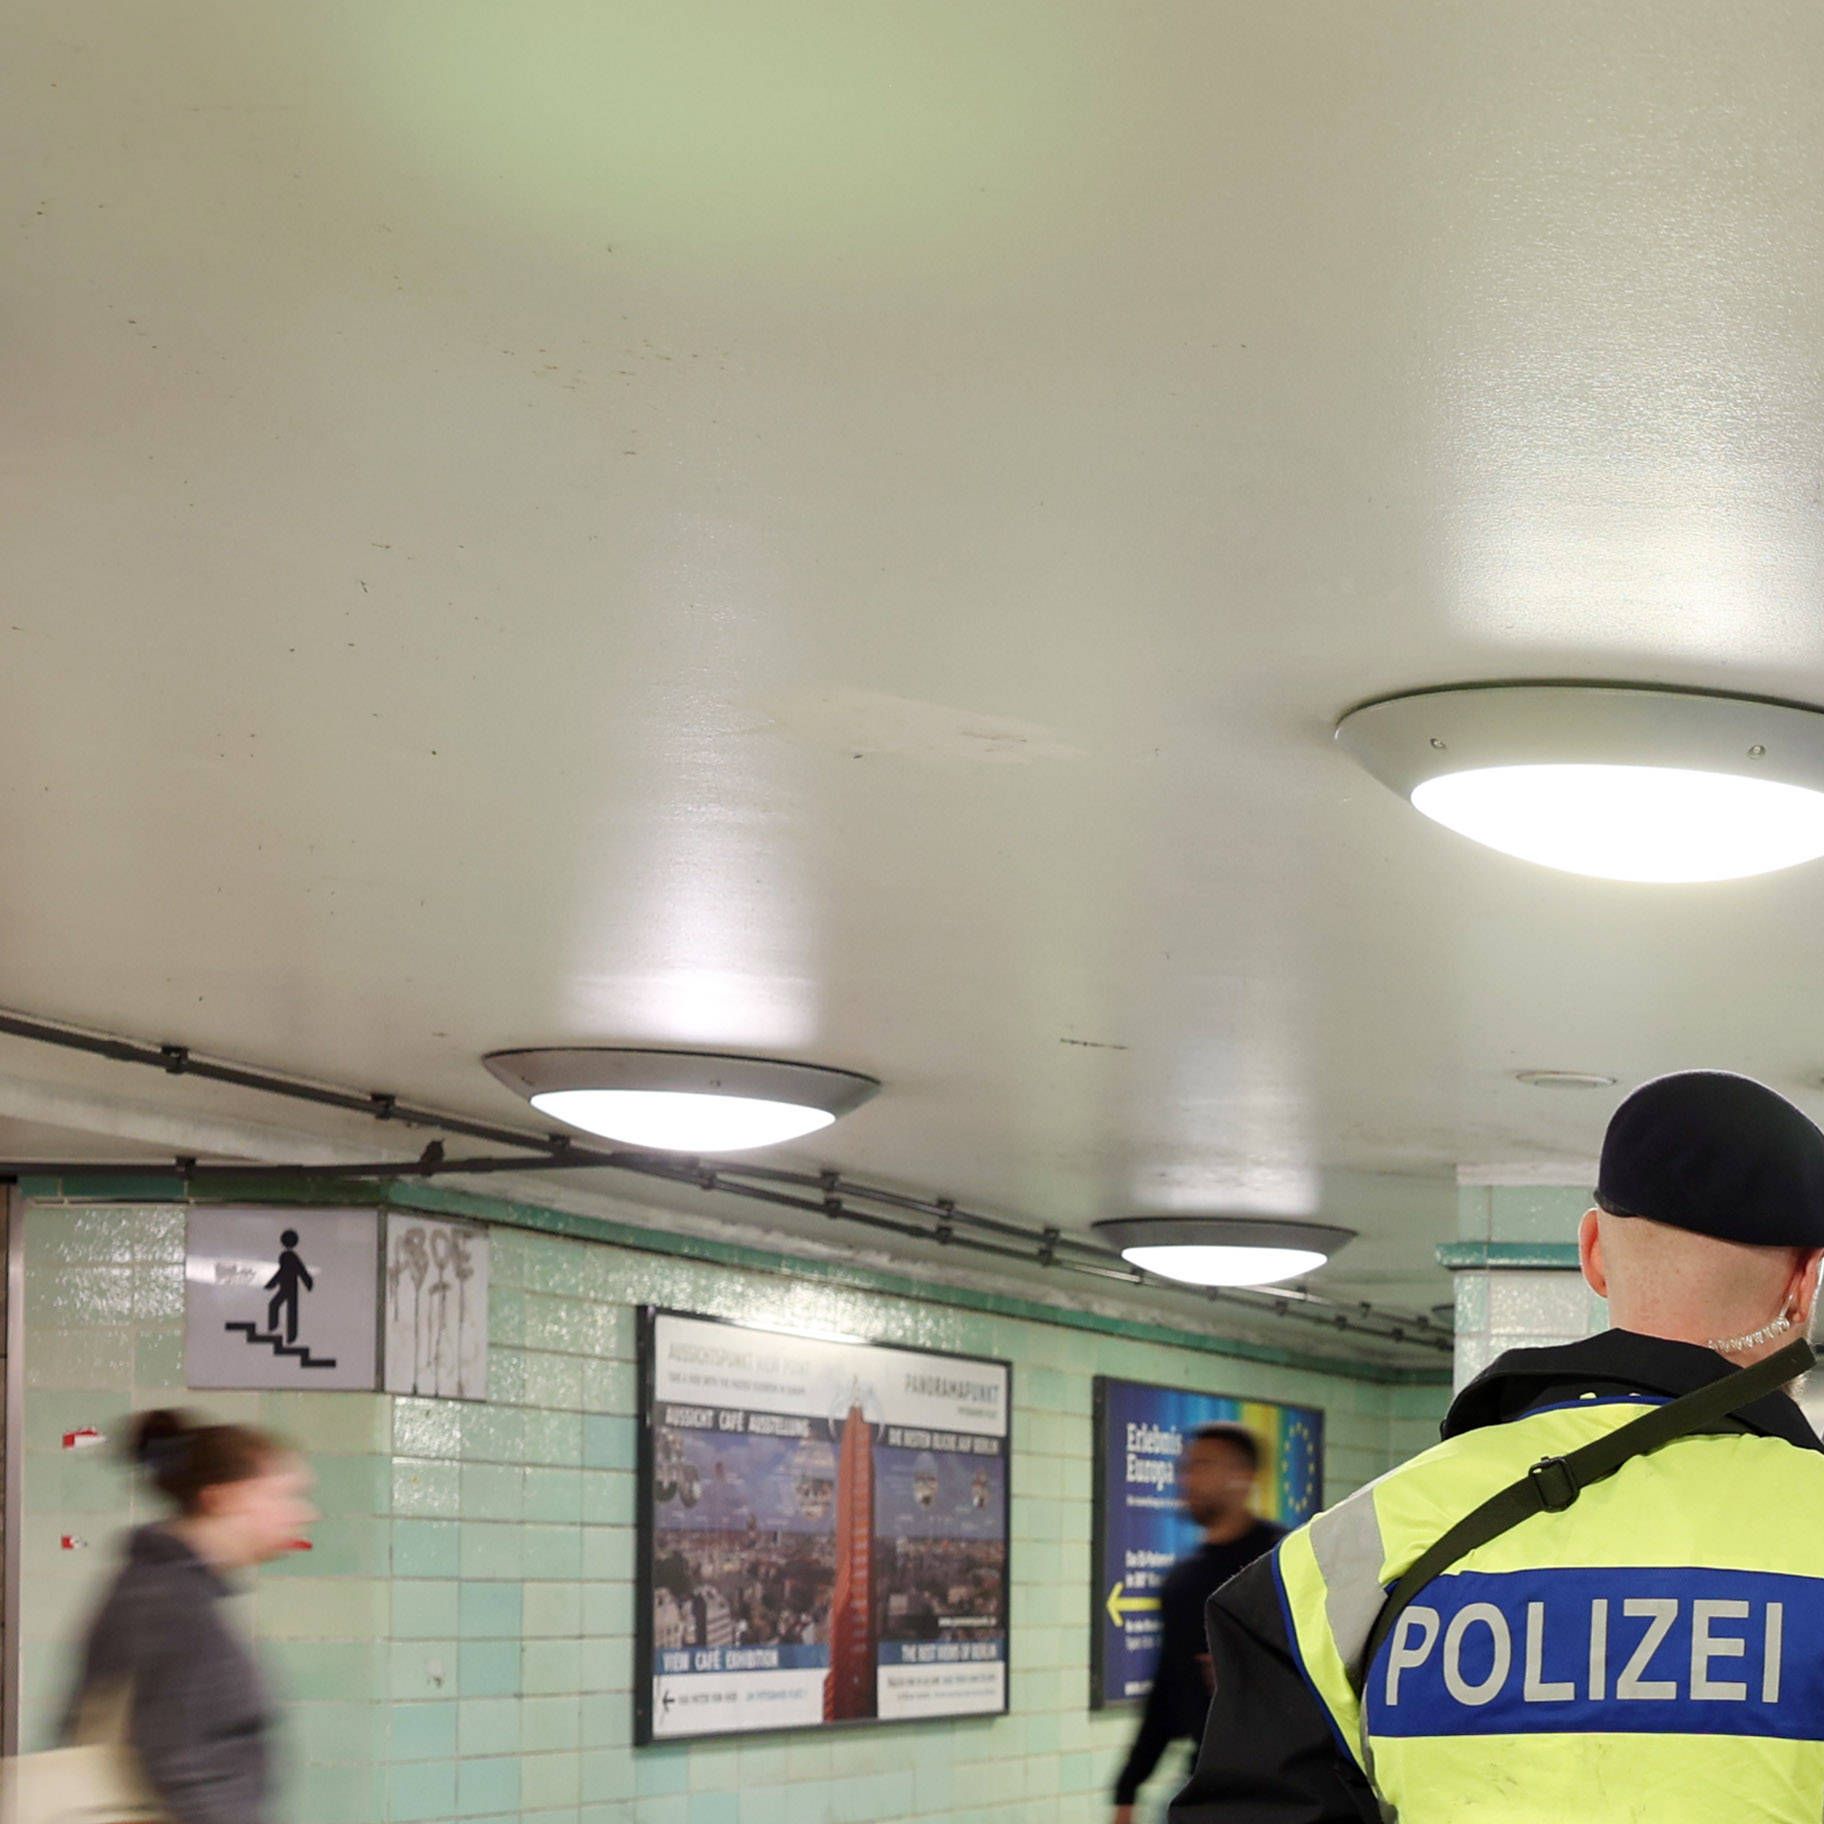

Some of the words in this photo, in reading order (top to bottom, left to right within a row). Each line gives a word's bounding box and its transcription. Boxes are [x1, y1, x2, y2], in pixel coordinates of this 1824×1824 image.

[905, 1373, 999, 1403] PANORAMAPUNKT
[665, 1407, 714, 1430] AUSSICHT
[718, 1409, 745, 1432] CAFÉ
[1126, 1422, 1183, 1456] Erlebnis
[1126, 1454, 1175, 1491] Europa
[663, 1651, 690, 1671] VIEW
[694, 1649, 721, 1670] CAFÉ
[725, 1649, 778, 1668] EXHIBITION
[1385, 1598, 1783, 1706] POLIZEI
